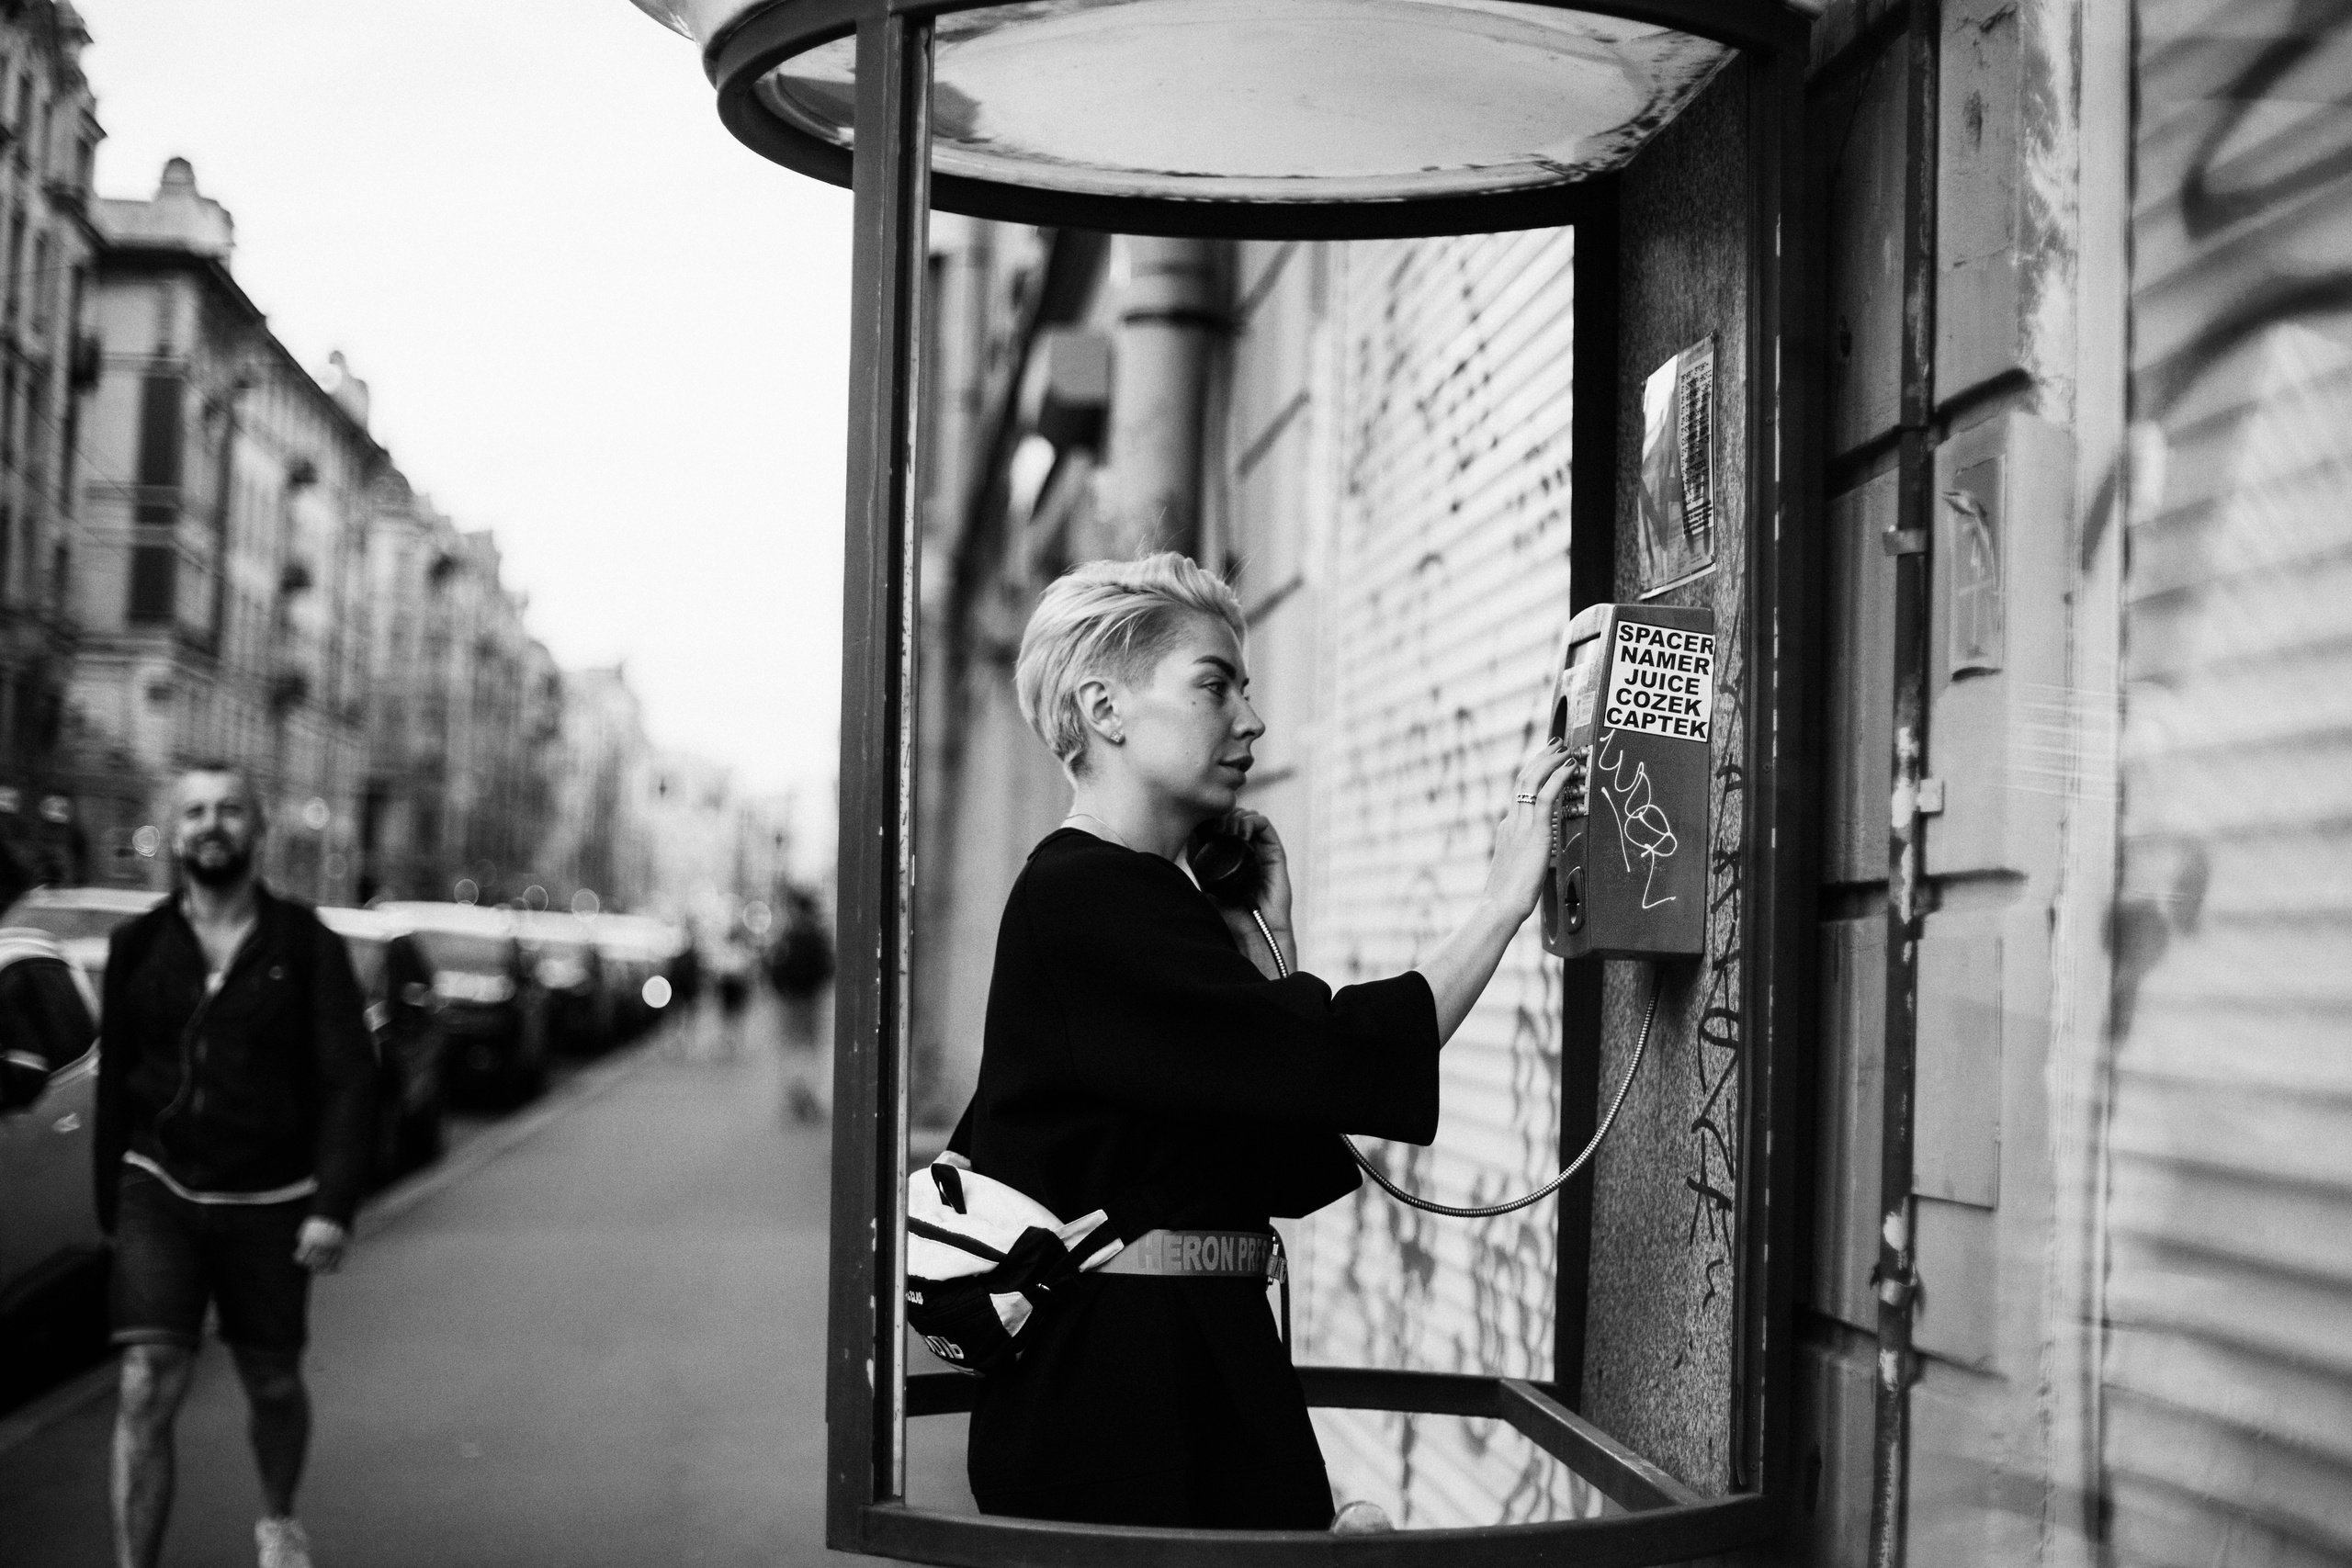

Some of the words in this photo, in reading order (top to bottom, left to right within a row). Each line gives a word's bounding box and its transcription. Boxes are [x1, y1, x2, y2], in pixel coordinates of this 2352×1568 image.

[1618, 624, 1714, 655] SPACER
[1620, 645, 1711, 675] NAMER
[1623, 669, 1701, 695] JUICE
[1615, 688, 1702, 717] COZEK
[1606, 707, 1708, 739] CAPTEK
[1137, 1235, 1235, 1271] HERON
